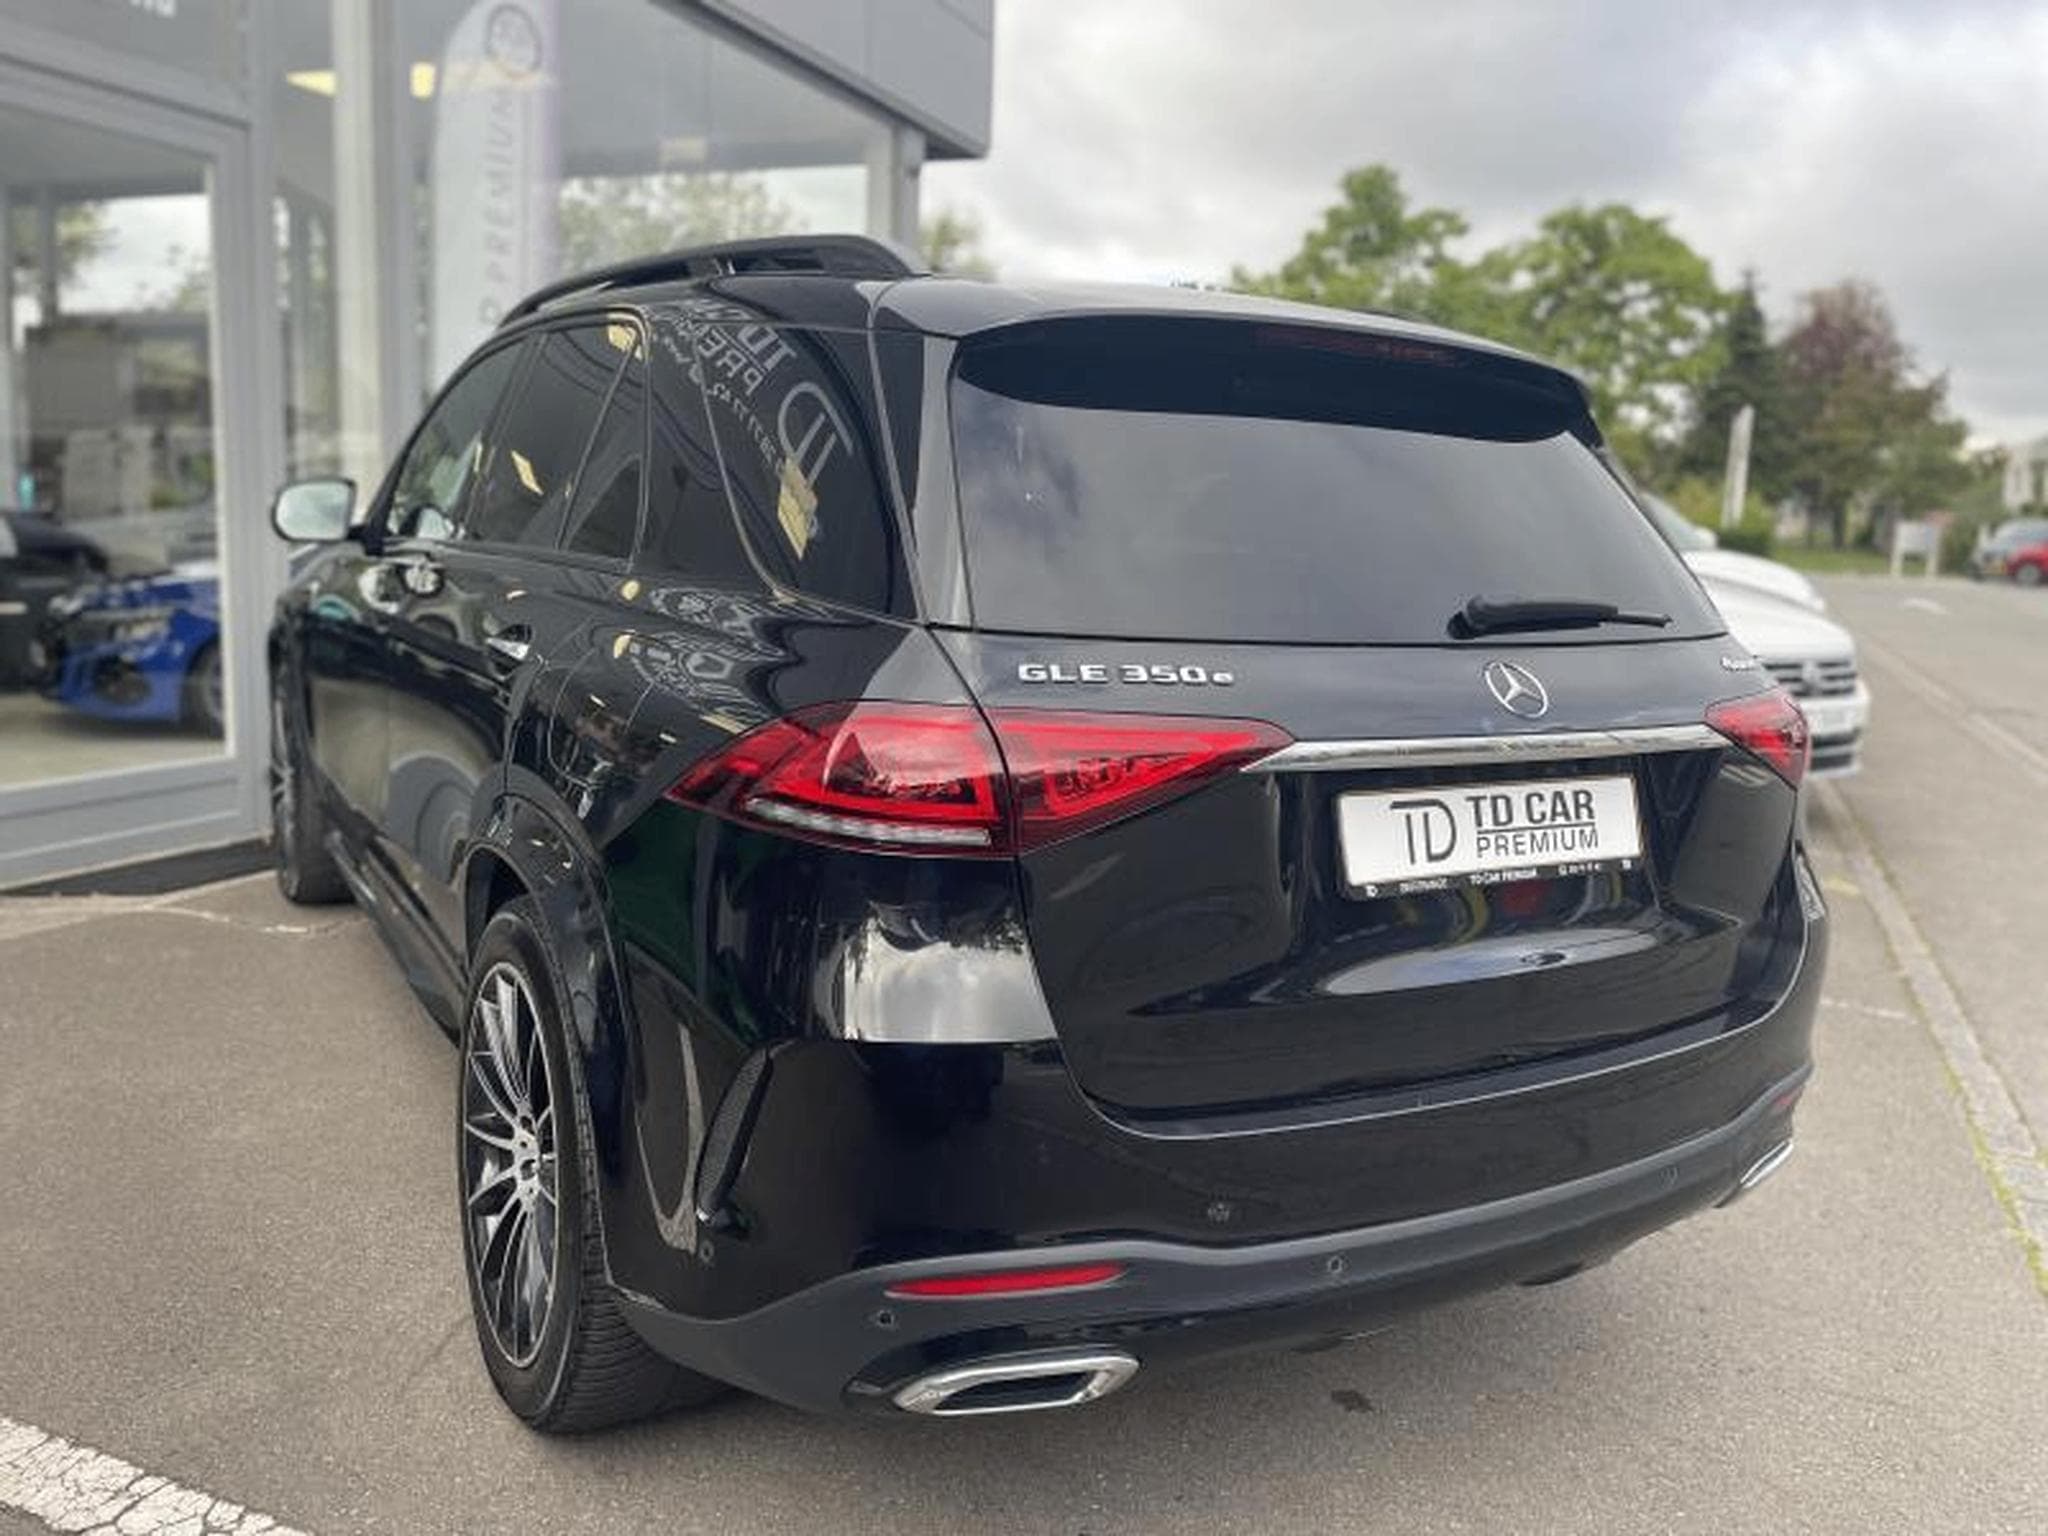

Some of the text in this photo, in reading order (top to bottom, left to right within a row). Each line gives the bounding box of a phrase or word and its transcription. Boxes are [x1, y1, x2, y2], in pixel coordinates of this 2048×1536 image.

[1018, 664, 1109, 684] GLE
[1464, 789, 1596, 829] TD CAR
[1389, 798, 1458, 865] TD
[1475, 828, 1599, 859] PREMIUM
